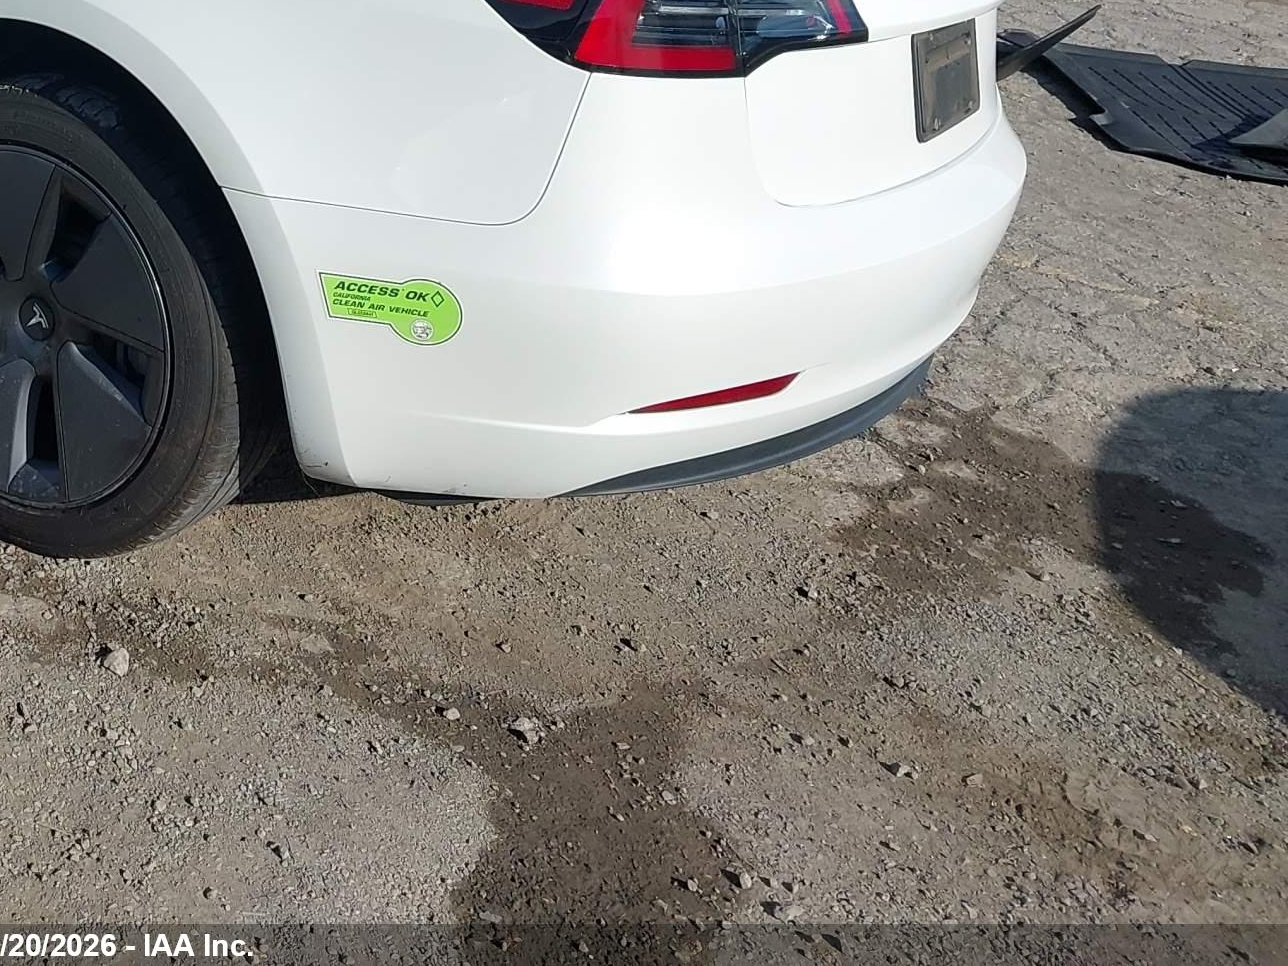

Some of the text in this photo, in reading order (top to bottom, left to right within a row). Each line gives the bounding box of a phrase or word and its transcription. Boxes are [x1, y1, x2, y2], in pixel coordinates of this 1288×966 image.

[333, 292, 371, 301] CALIFORNIA
[334, 280, 430, 302] ACCESS OK
[332, 298, 430, 317] CLEAN AIR VEHICLE
